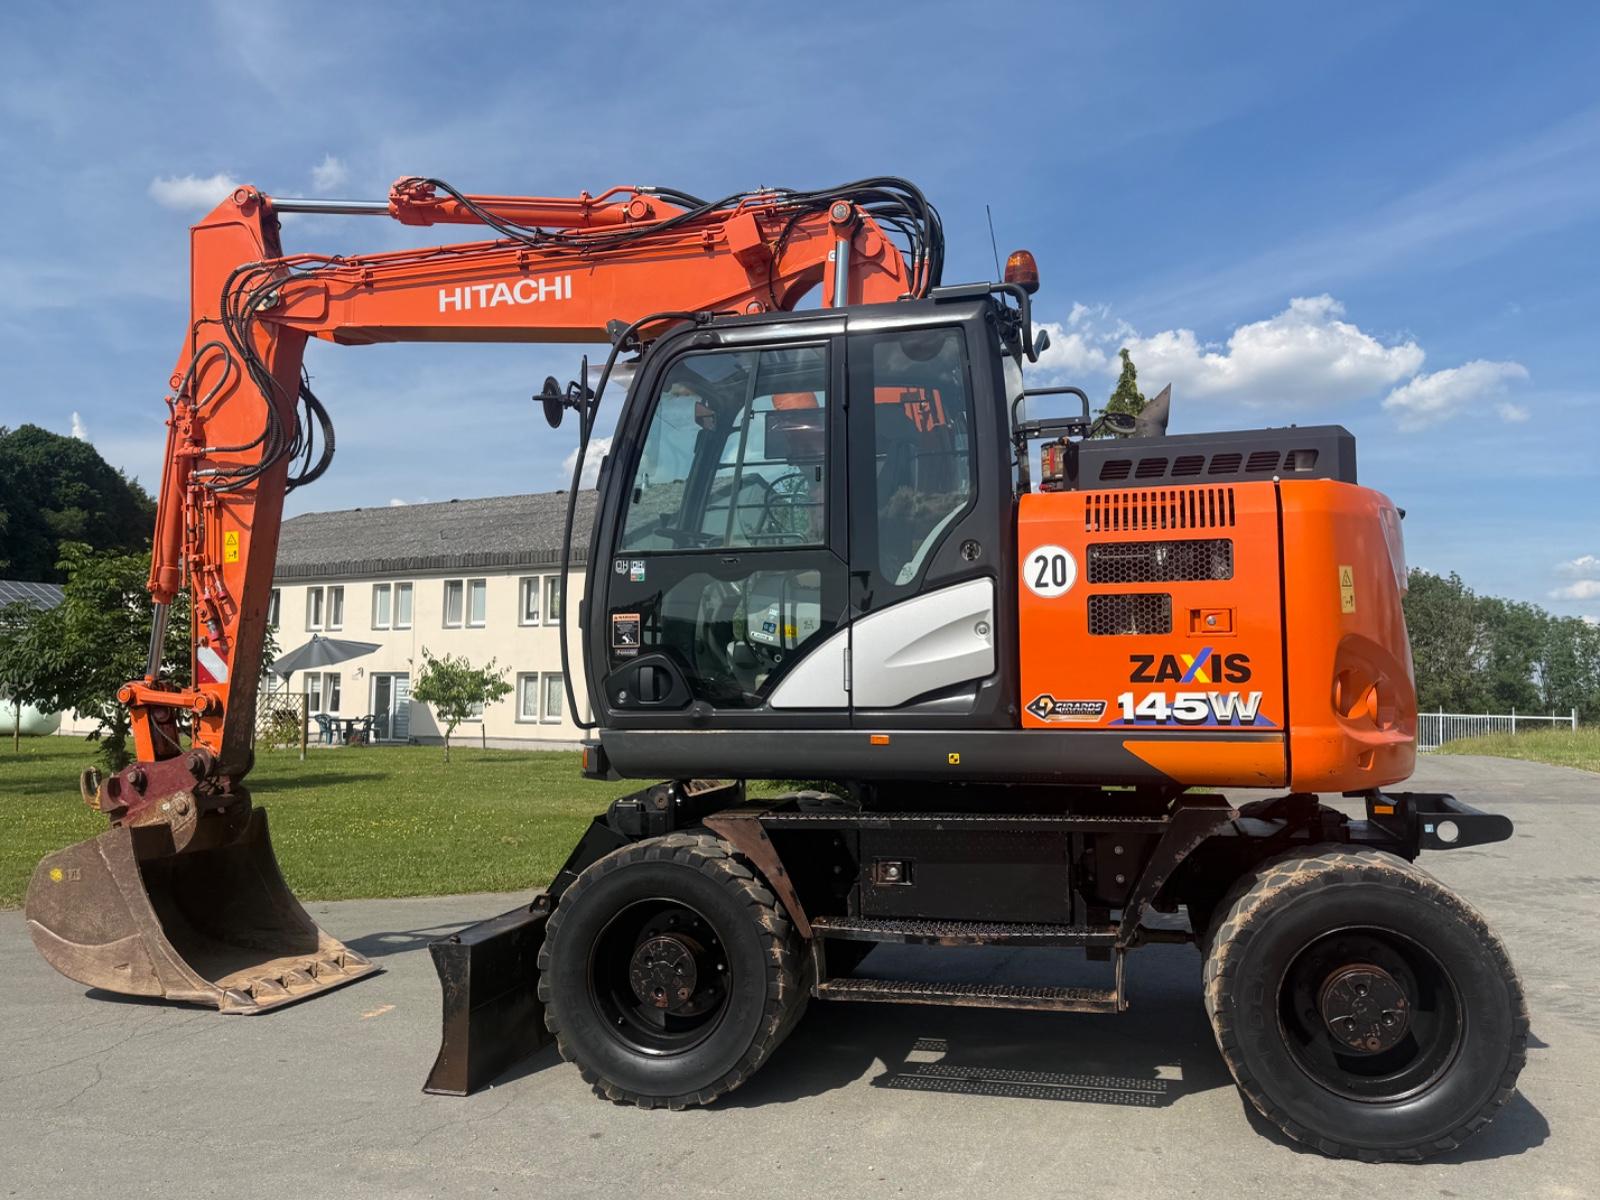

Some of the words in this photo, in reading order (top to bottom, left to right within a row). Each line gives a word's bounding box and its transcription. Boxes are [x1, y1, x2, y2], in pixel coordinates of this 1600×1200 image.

[438, 275, 572, 312] HITACHI
[1034, 554, 1067, 588] 20
[1129, 647, 1252, 684] ZAXIS
[1117, 691, 1263, 725] 145W
